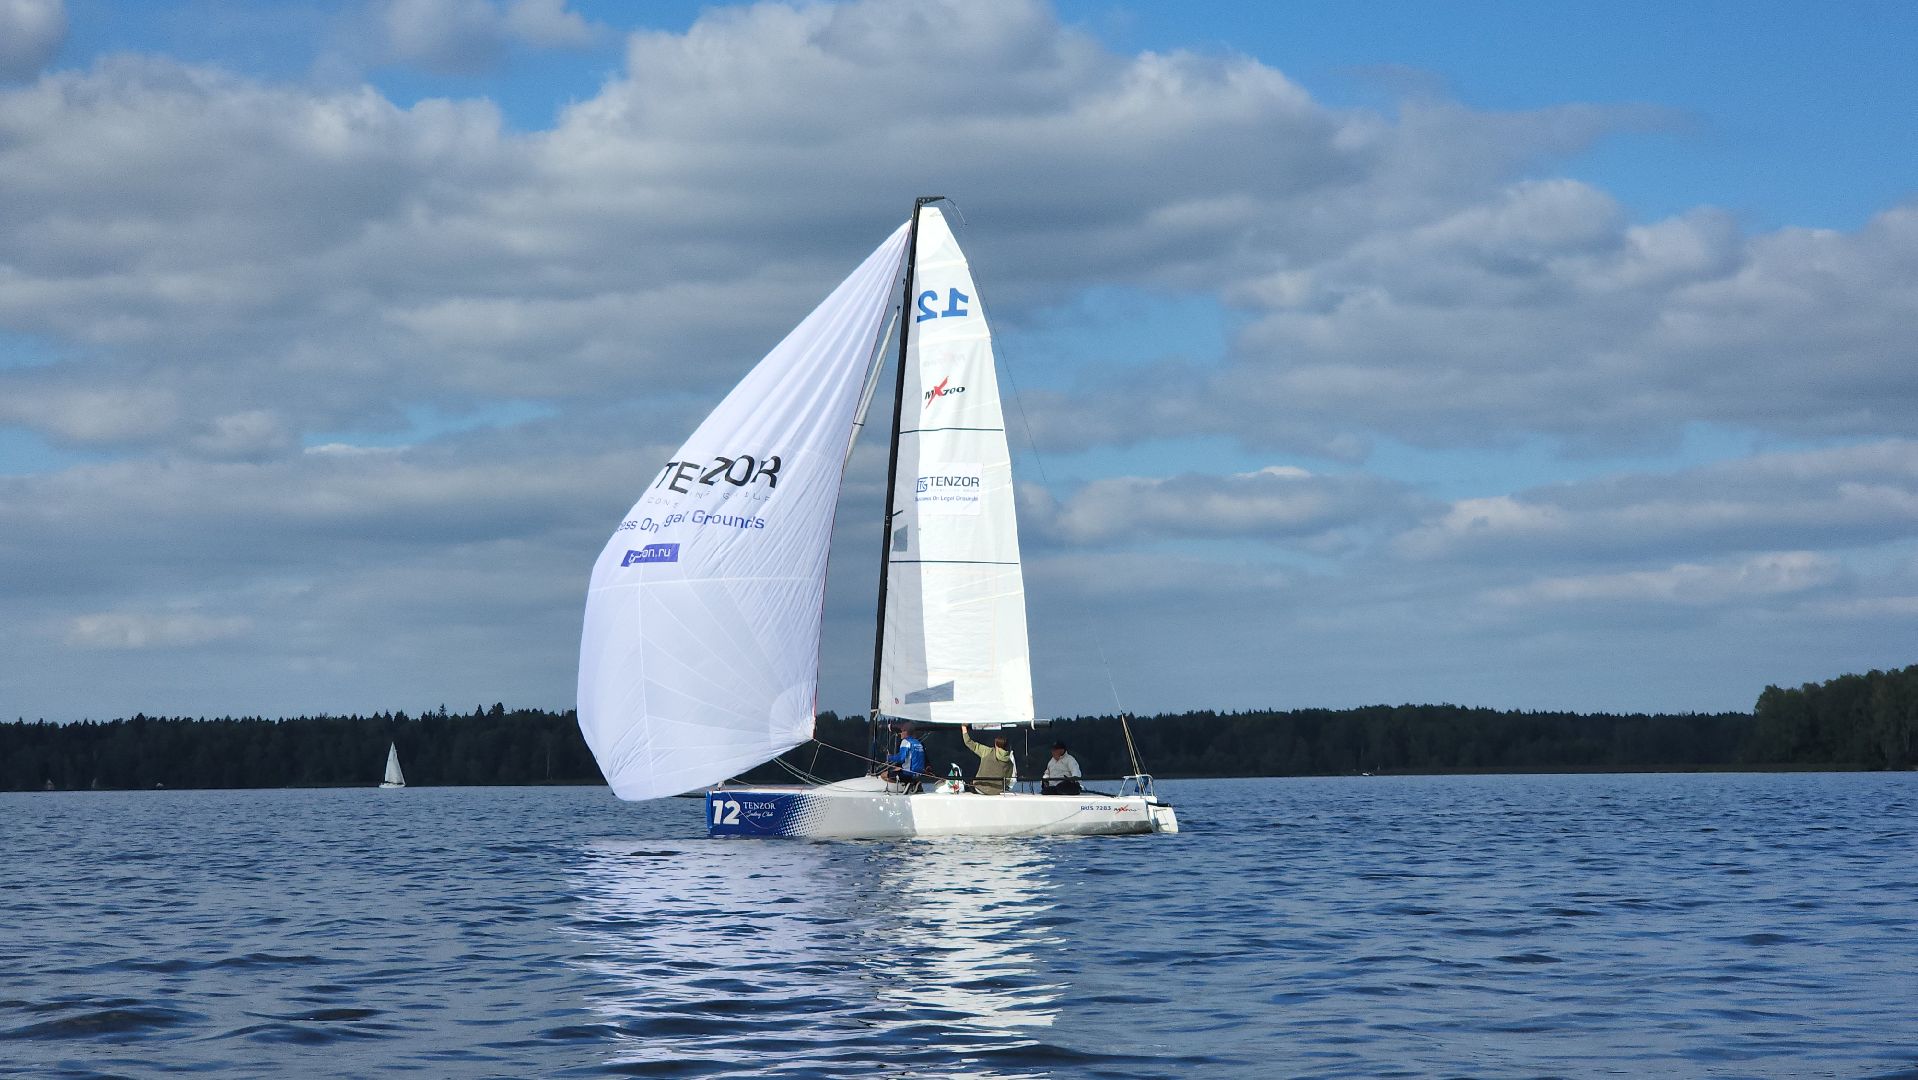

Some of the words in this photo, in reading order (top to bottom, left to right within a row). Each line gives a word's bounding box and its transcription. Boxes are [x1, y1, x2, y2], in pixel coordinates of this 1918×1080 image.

[656, 455, 782, 494] TEZOR
[929, 476, 980, 487] TENZOR
[640, 517, 659, 534] On
[663, 510, 690, 528] gal
[691, 509, 766, 530] Grounds
[712, 800, 741, 825] 12
[743, 801, 776, 810] TENZOR
